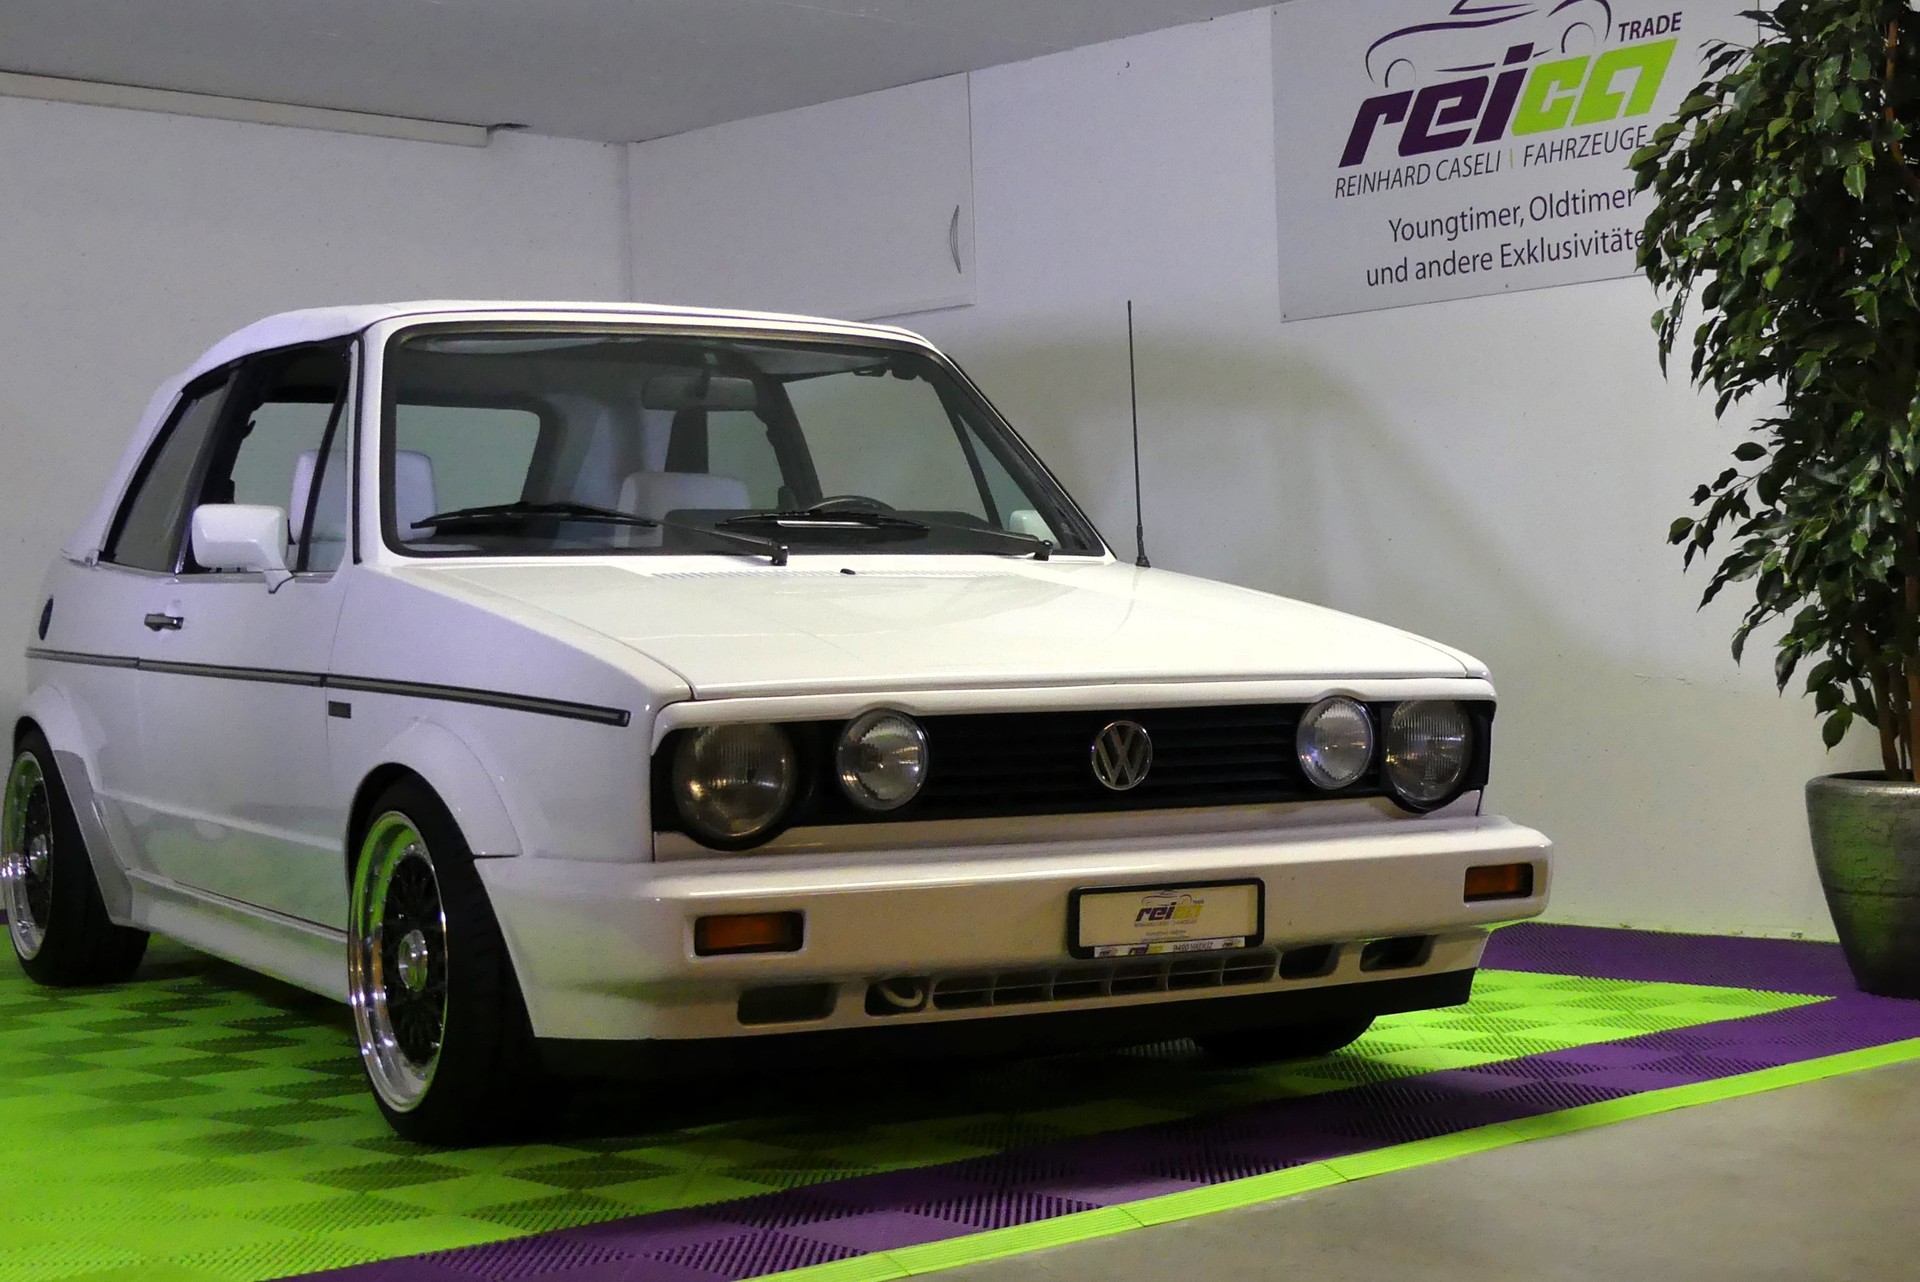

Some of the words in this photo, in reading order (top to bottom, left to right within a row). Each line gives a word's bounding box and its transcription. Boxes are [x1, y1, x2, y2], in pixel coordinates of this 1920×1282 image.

[1618, 12, 1682, 42] TRADE
[1335, 163, 1431, 199] REINHARD
[1435, 151, 1501, 182] CASELI
[1522, 125, 1648, 168] FAHRZEUGE
[1388, 204, 1525, 244] Youngtimer,
[1529, 187, 1636, 225] Oldtimer
[1366, 257, 1409, 287] und
[1415, 252, 1493, 281] andere
